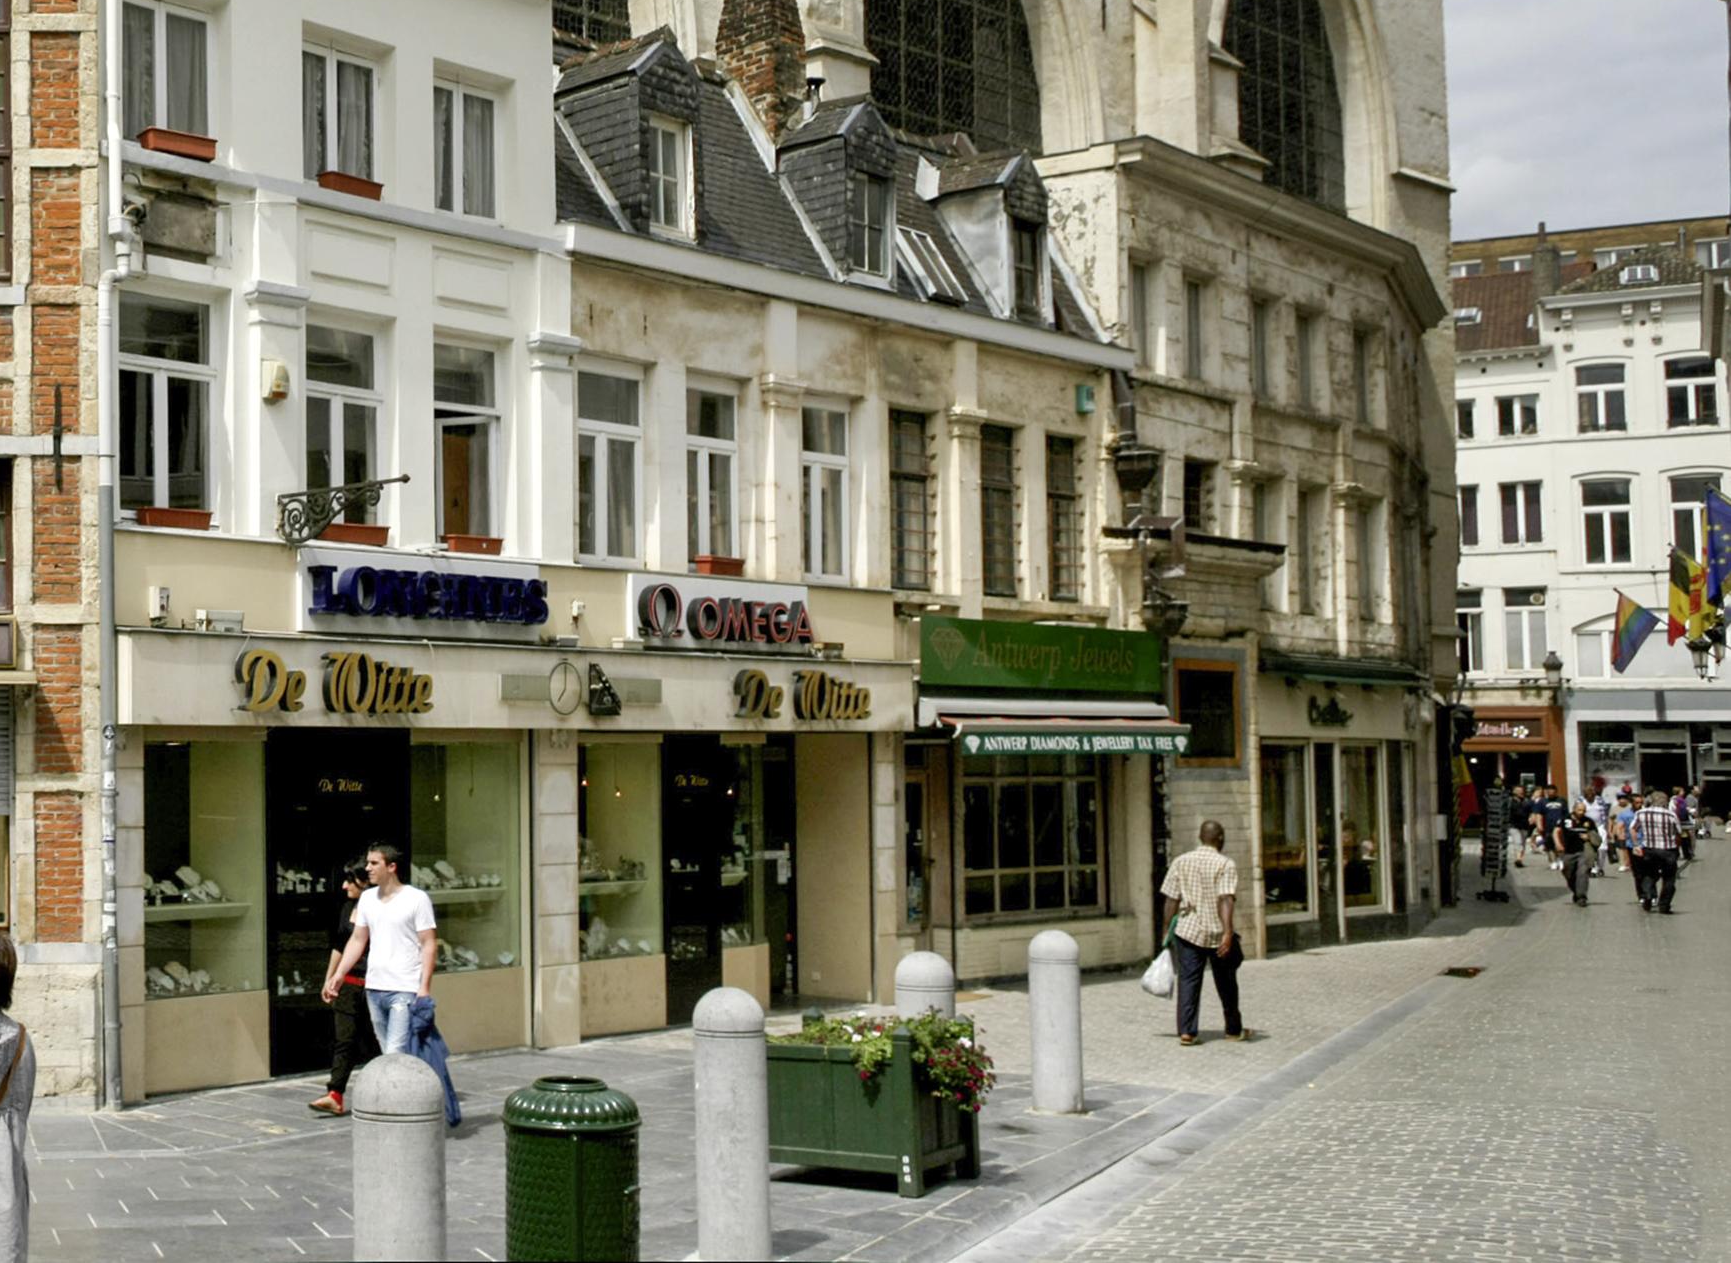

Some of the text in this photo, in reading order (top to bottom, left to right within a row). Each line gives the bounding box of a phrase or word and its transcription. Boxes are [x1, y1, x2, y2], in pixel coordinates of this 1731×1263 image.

[307, 565, 549, 625] LONGINES
[686, 596, 815, 644] OMEGA
[972, 626, 1134, 679] Antwerp Jewels
[234, 648, 434, 714] De Witte
[733, 668, 872, 720] De Witte
[984, 736, 1174, 752] ANTWERP DIAMONDS & JEWELLERY TAX FREE
